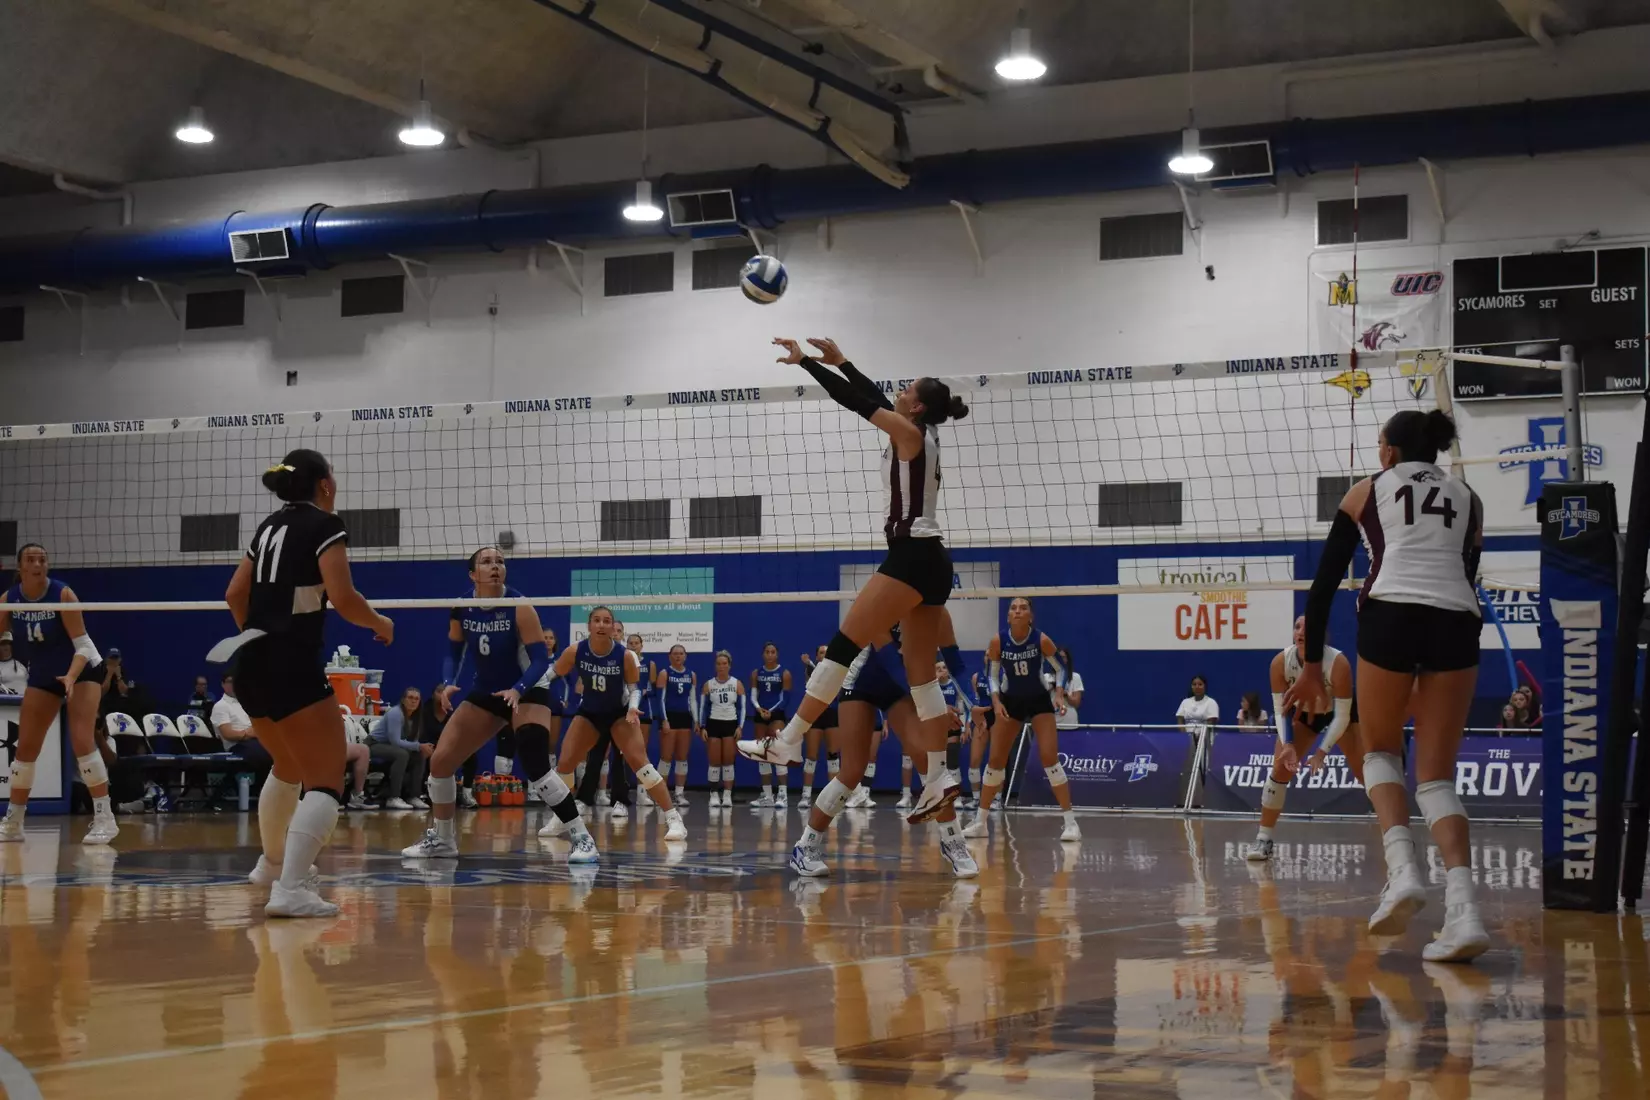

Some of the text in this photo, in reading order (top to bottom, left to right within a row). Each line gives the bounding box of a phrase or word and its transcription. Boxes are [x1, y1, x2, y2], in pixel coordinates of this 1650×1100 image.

[1392, 272, 1444, 296] UIC
[1458, 295, 1525, 311] SYCAMORES
[1591, 287, 1637, 303] GUEST
[1539, 299, 1558, 309] SET
[1615, 339, 1640, 349] SETS
[1226, 353, 1339, 374] INDIANA STATE
[1027, 366, 1132, 385] INDIANA STATE
[1614, 377, 1641, 388] WON
[668, 388, 760, 405] INDIANA STATE
[1459, 385, 1484, 395] WON
[352, 405, 433, 421] INDIANA STATE
[505, 397, 591, 413] INDIANA STATE
[72, 420, 145, 434] INDIANA STATE
[208, 413, 284, 428] INDIANA STATE
[1394, 484, 1458, 529] 14
[1550, 510, 1598, 521] SYCAMORES
[256, 525, 288, 583] 11
[1175, 604, 1248, 640] CAFE
[479, 634, 490, 656] 6
[1001, 648, 1039, 661] SYCAMORES
[580, 661, 621, 675] SYCAMORES
[1013, 661, 1029, 676] 18
[592, 674, 606, 692] 19
[677, 683, 684, 694] 5
[765, 682, 772, 692] 3
[719, 693, 729, 704] 16
[1488, 749, 1511, 759] THE
[1455, 761, 1544, 797] ROV
[1562, 771, 1598, 880] STATE
